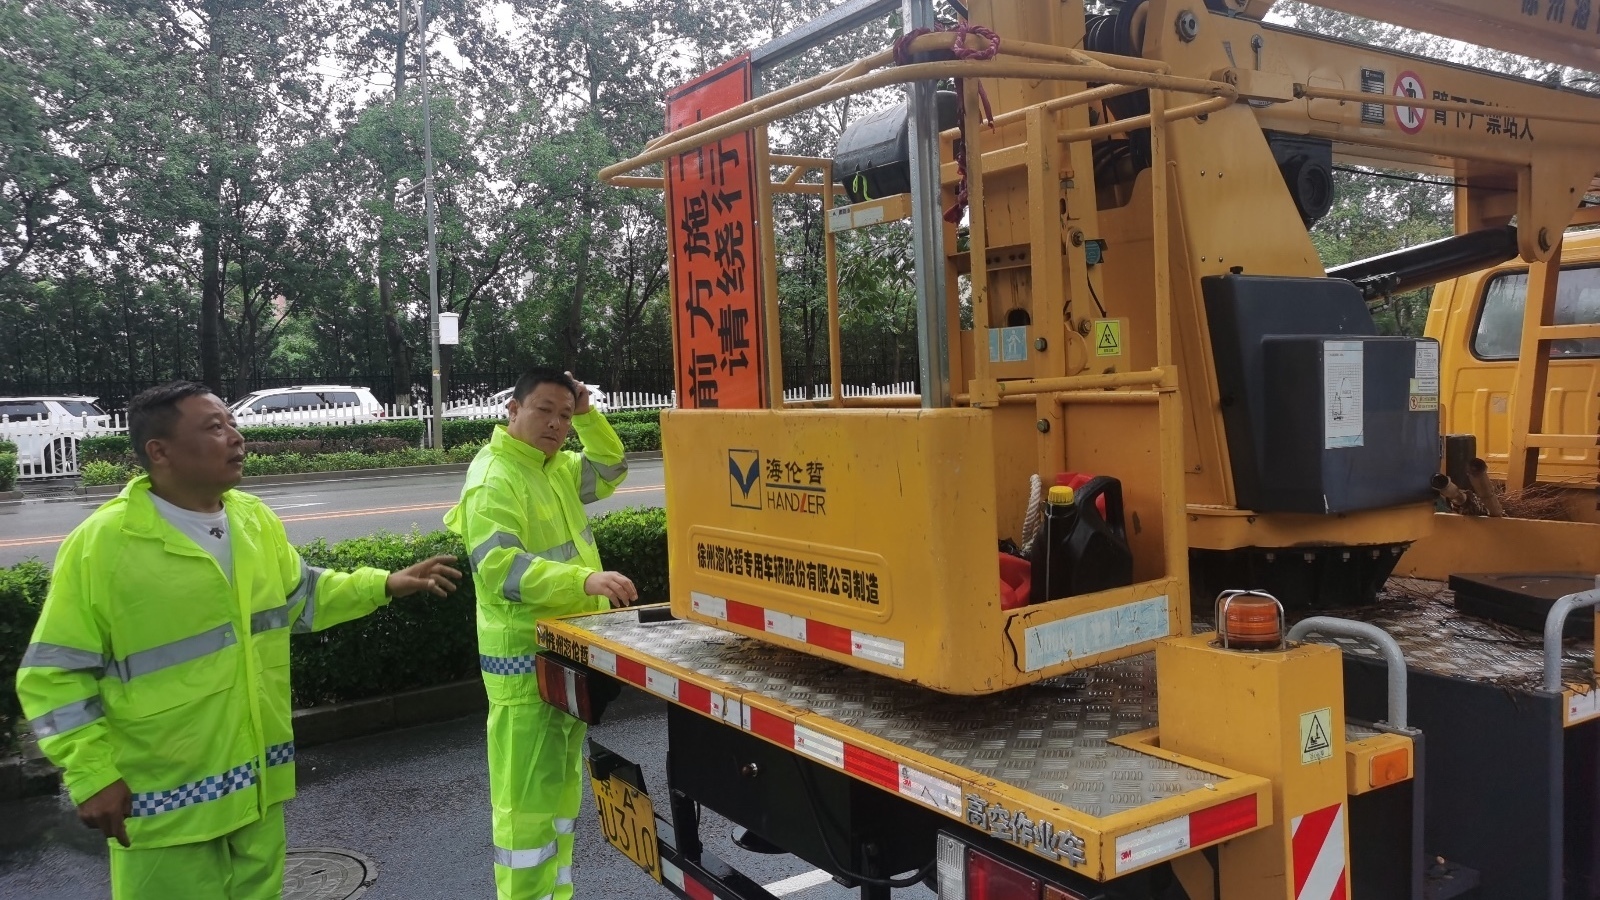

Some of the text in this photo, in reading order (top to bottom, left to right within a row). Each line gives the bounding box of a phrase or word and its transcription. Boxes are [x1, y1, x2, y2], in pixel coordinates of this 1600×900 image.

[710, 139, 749, 376] 请绕行
[766, 458, 824, 484] 海伦哲
[767, 491, 826, 515] HANDLER
[697, 542, 880, 605] 徐州海伦哲专用车辆股份有限公司制造
[902, 778, 911, 787] 3M
[965, 793, 1087, 867] 高空作业车
[1120, 849, 1131, 861] 3M
